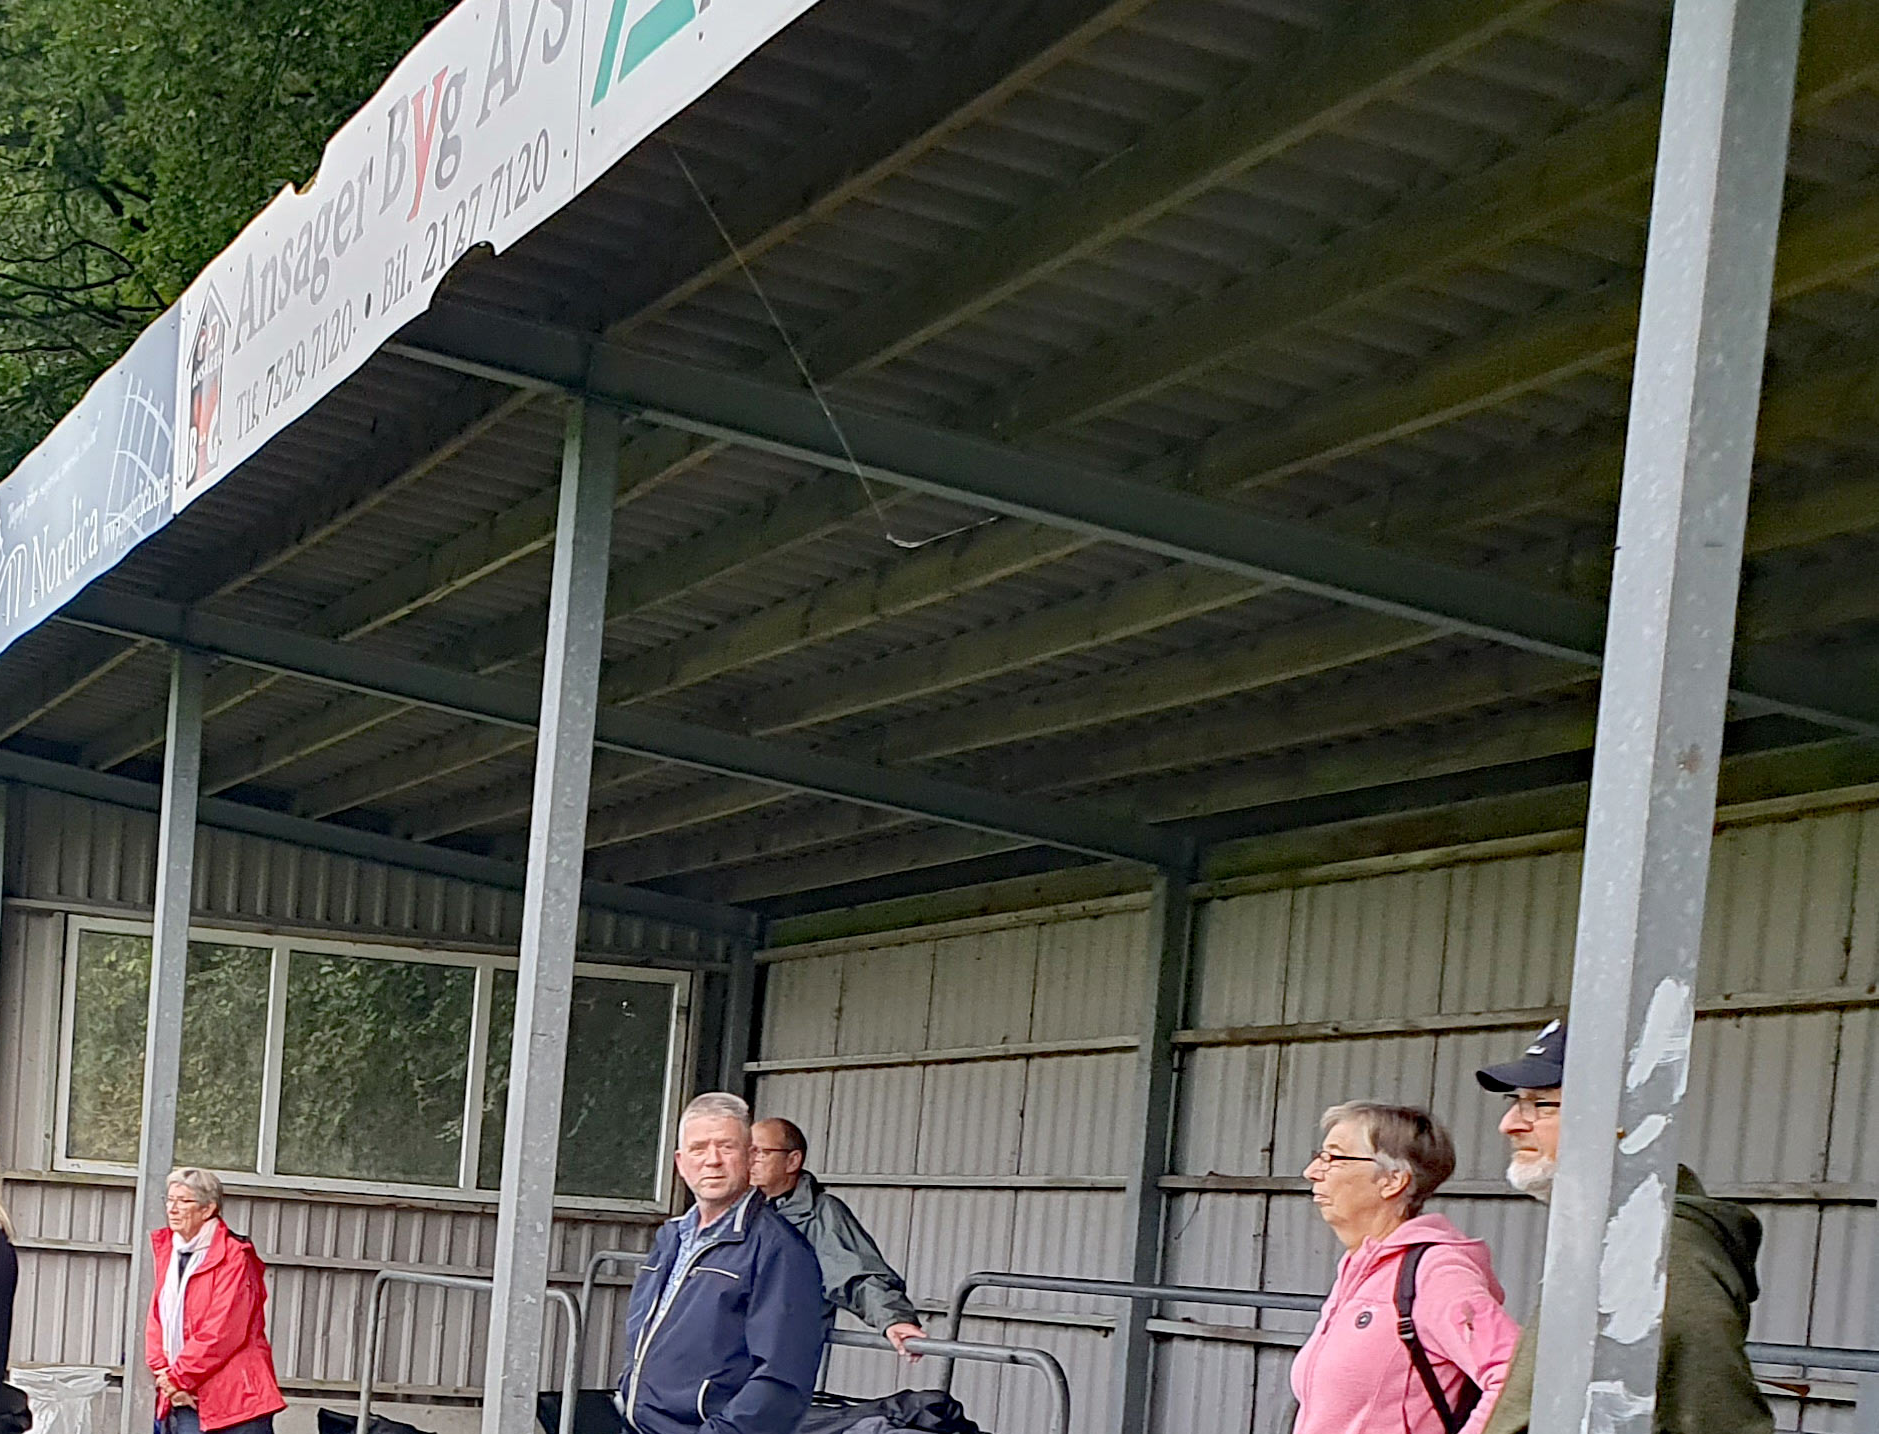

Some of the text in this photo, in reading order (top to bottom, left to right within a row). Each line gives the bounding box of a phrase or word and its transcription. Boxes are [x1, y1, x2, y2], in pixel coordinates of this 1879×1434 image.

[232, 0, 573, 355] Ansager Byg A/S
[266, 340, 306, 417] 7529
[380, 244, 412, 316] Bil.
[421, 184, 483, 284] 2127
[488, 128, 549, 232] 7120
[28, 496, 100, 608] Nordica
